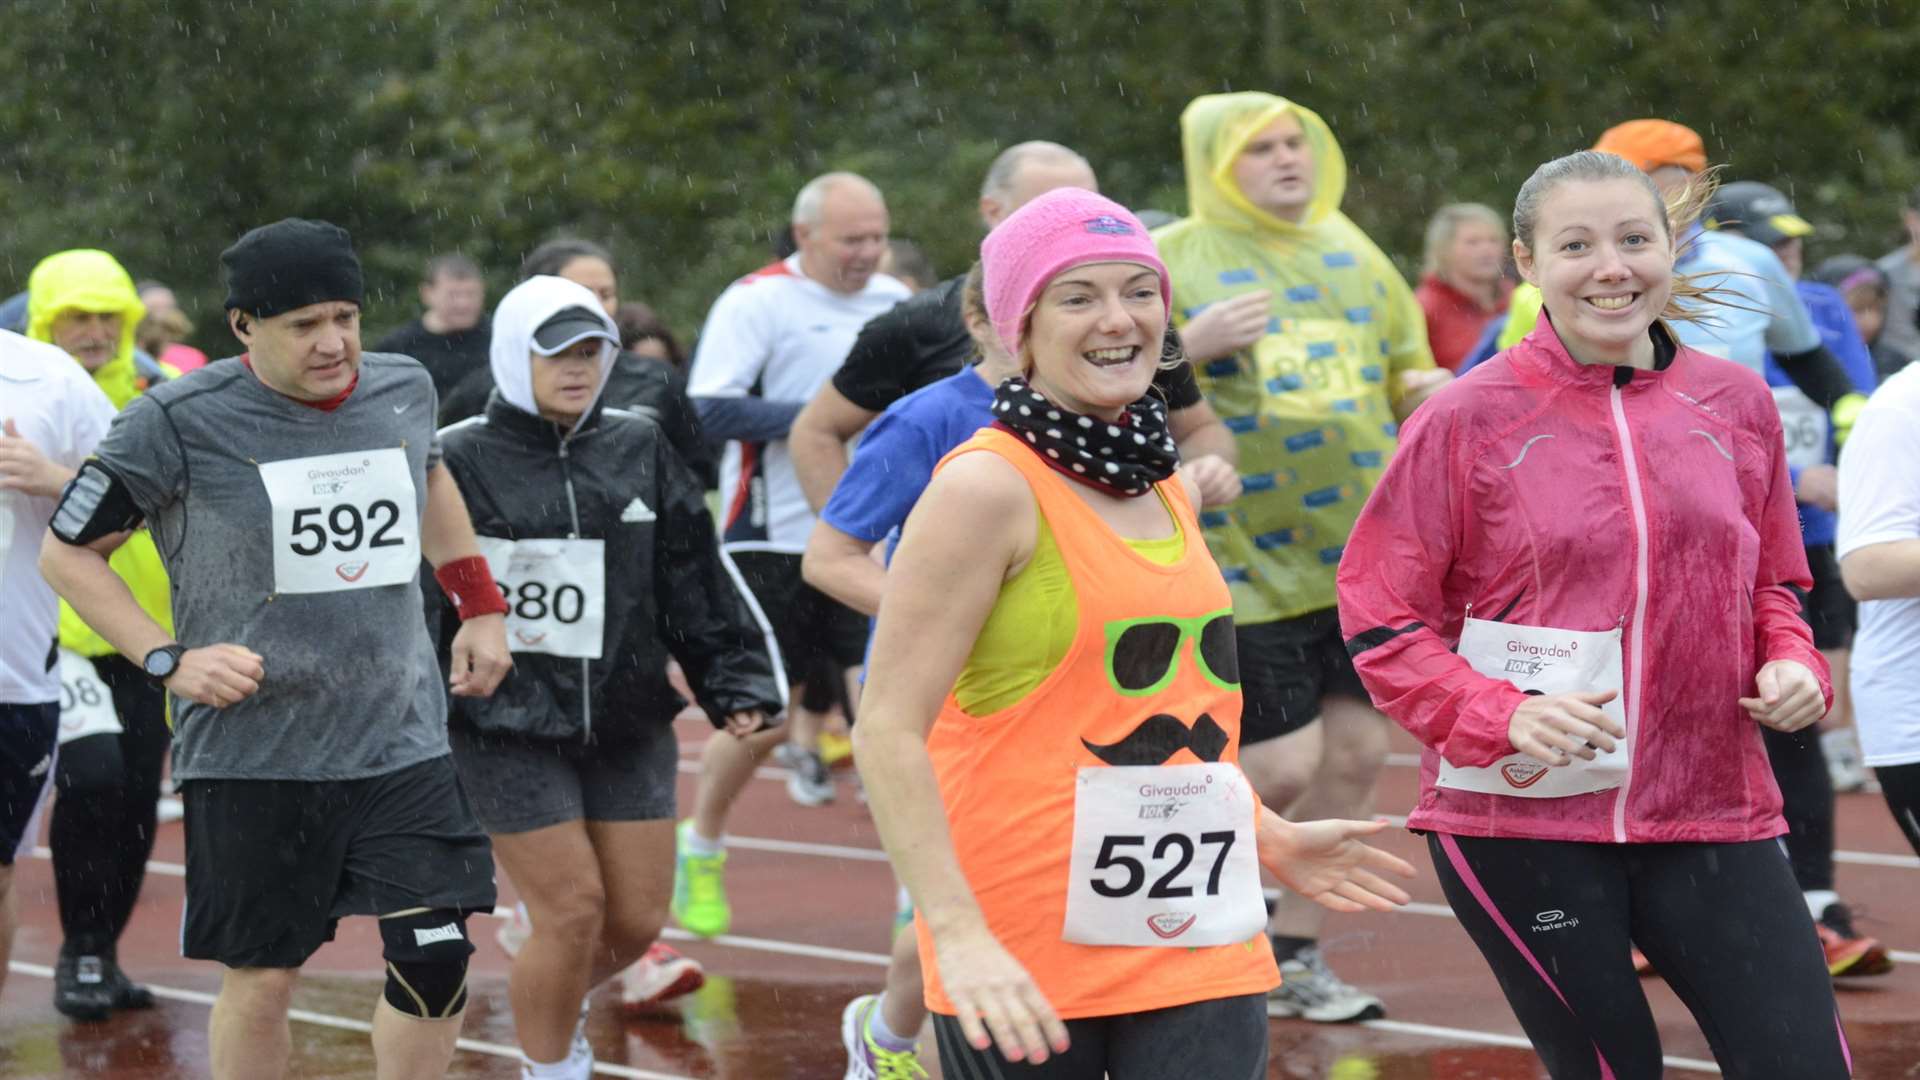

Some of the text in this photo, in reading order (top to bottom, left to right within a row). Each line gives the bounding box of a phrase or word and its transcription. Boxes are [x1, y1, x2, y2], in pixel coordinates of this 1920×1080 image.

[290, 499, 405, 556] 592
[1506, 640, 1572, 659] Givaudan
[1507, 659, 1533, 674] 10K
[1138, 782, 1207, 798] Givaudan
[1090, 830, 1236, 899] 527
